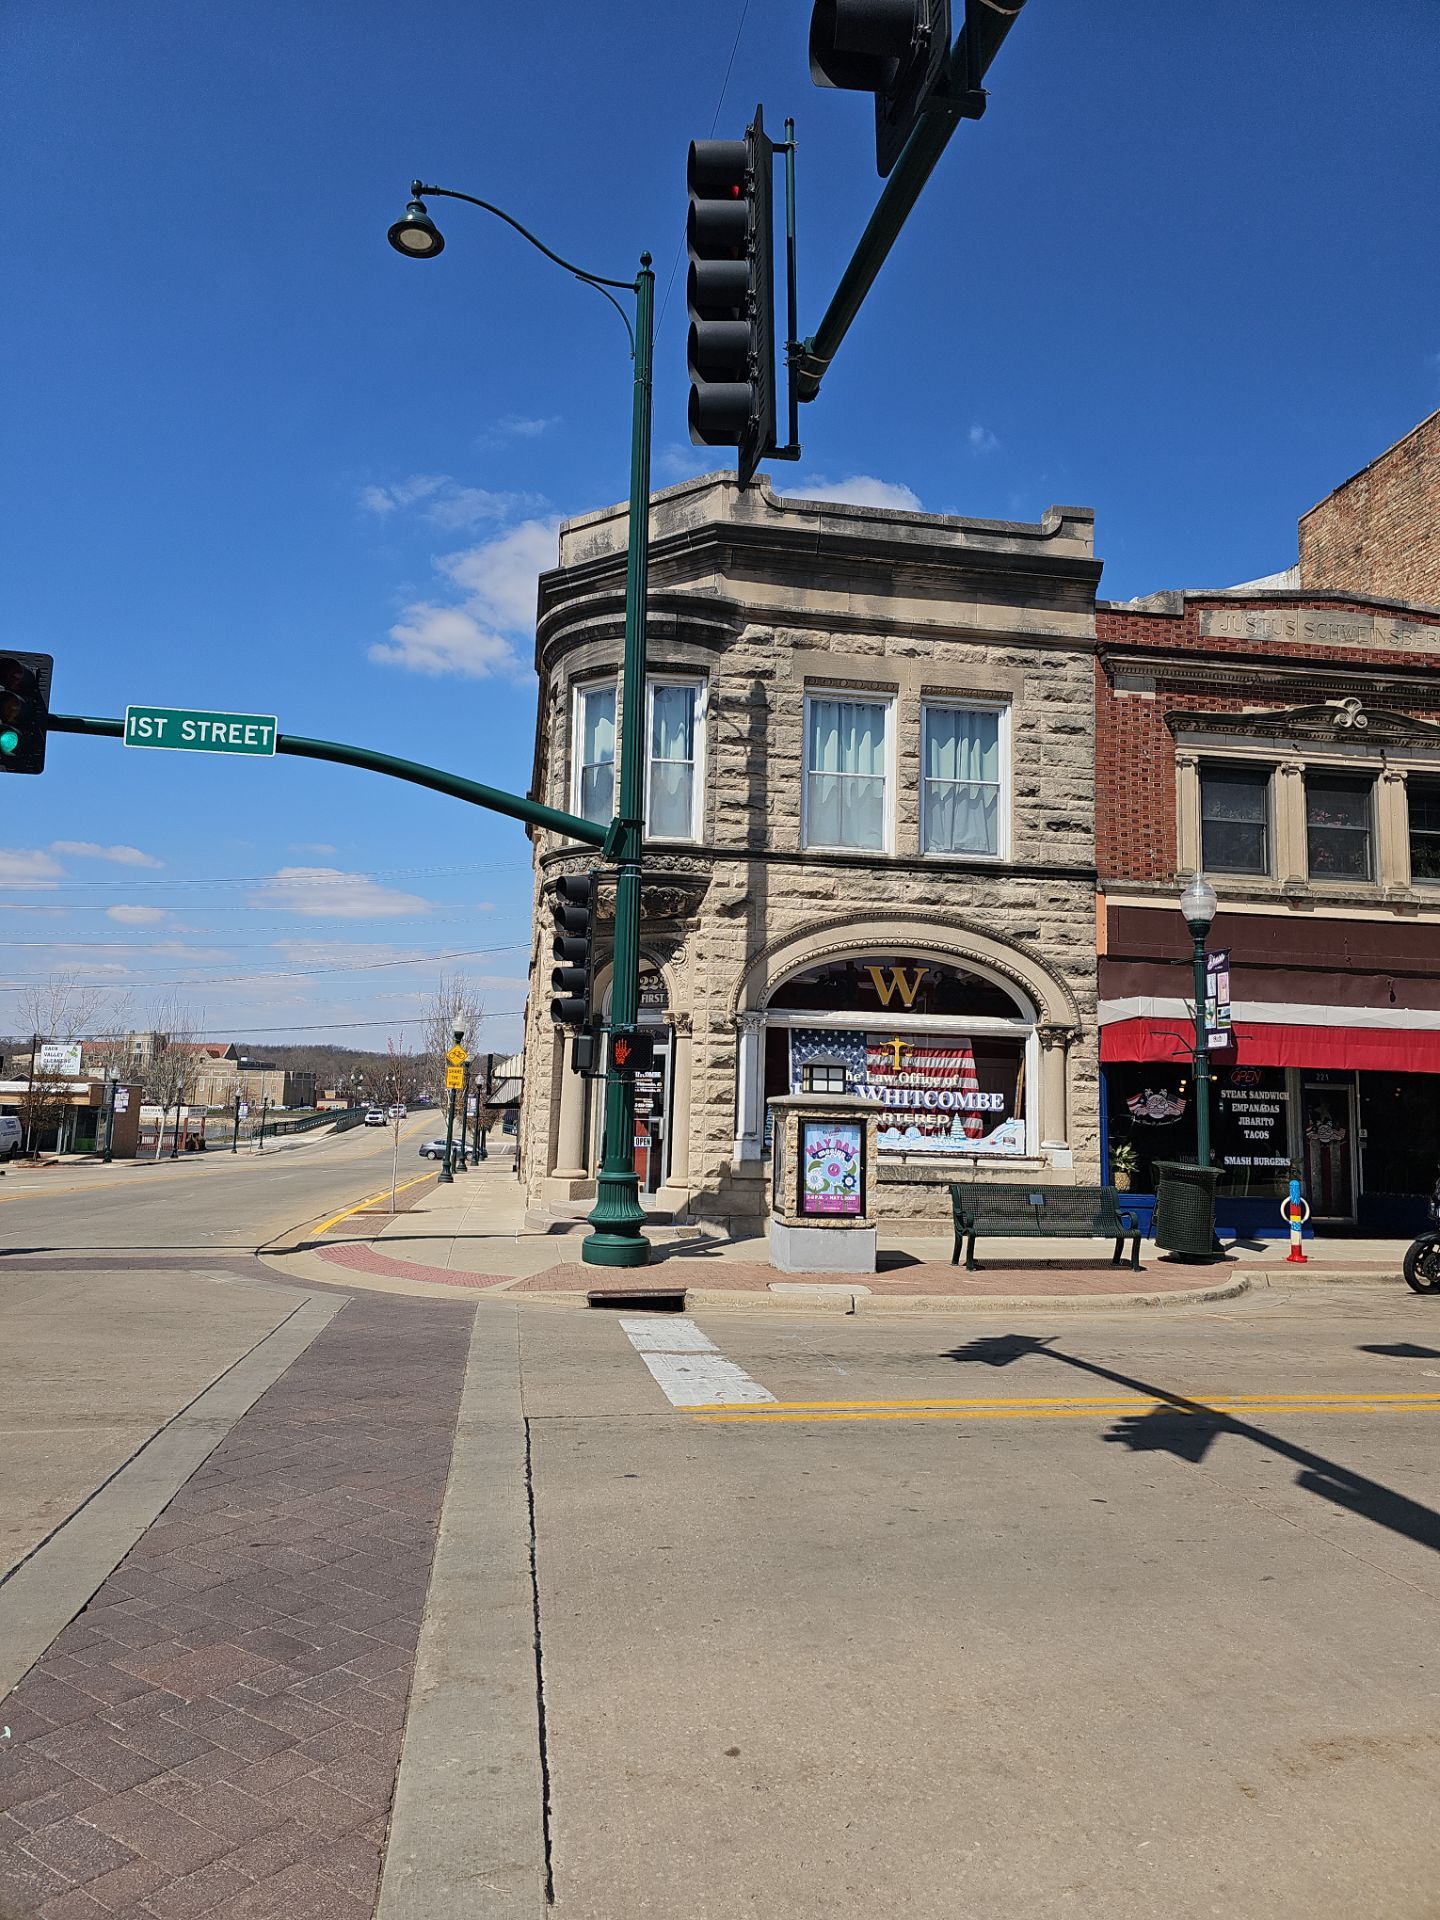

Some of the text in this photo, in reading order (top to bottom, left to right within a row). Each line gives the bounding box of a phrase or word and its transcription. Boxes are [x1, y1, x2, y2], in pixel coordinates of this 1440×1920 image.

[1220, 615, 1440, 648] JUSTUS SCHWEINSBER
[129, 716, 273, 746] 1ST STREET
[863, 965, 930, 1008] W
[641, 993, 665, 1003] FIRST
[845, 1069, 960, 1087] he Law Office of
[1231, 1070, 1262, 1083] OPEN
[855, 1084, 1005, 1111] WHITCOMBE
[1220, 1089, 1290, 1101] STEAK SANDWICH
[1231, 1103, 1280, 1113] EMPANADAS
[876, 1112, 950, 1126] ARTERED
[1238, 1116, 1275, 1126] JIBARITO
[1243, 1130, 1270, 1139] TACOS
[635, 1137, 651, 1146] OPEN
[805, 1138, 859, 1158] MAY DAY
[1224, 1156, 1291, 1166] SMASH BURGERS
